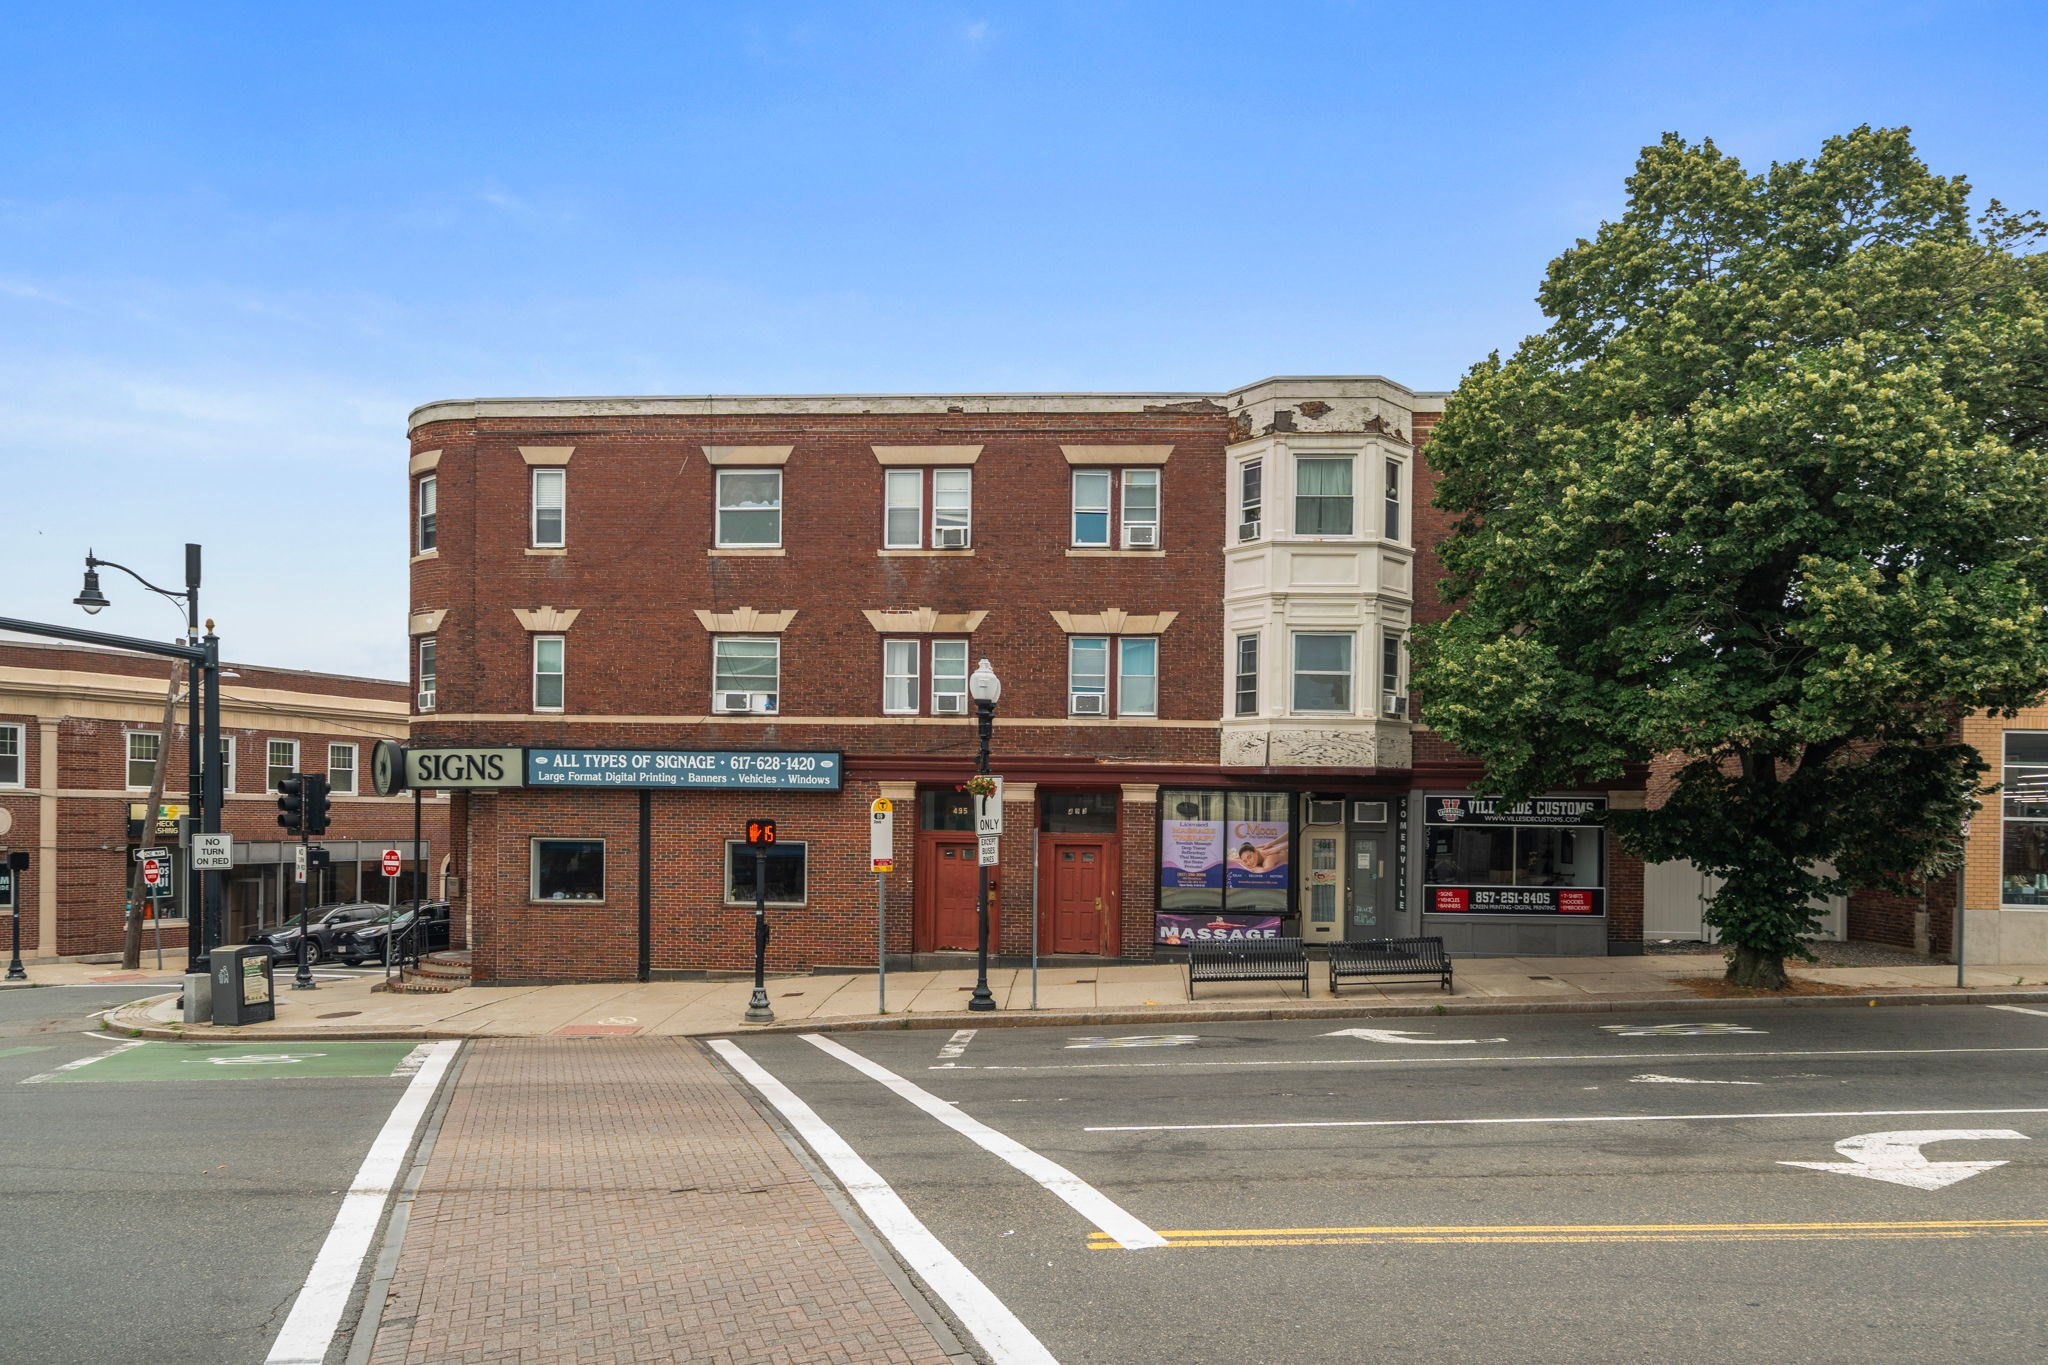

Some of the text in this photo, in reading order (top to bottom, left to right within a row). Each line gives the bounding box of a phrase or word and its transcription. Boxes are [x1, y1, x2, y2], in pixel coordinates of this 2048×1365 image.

[418, 754, 504, 781] SIGNS
[553, 754, 816, 771] ALL TYPES OF SIGNAGE 617-628-1420
[538, 771, 830, 785] Large Format Digital Printing Banners Vehicles Windows
[1468, 800, 1532, 815] VILLIDE
[980, 819, 999, 831] ONLY
[1484, 815, 1581, 823] WWW.VILLESIDECUSTOMS.COM
[764, 825, 774, 842] 15
[205, 838, 220, 846] NO
[981, 838, 996, 846] EXCEPT
[982, 847, 995, 855] BUSES
[1399, 799, 1407, 910] SOMERVILLE
[1475, 891, 1550, 904] 857-251-8405
[1160, 926, 1276, 940] MASSAGE
